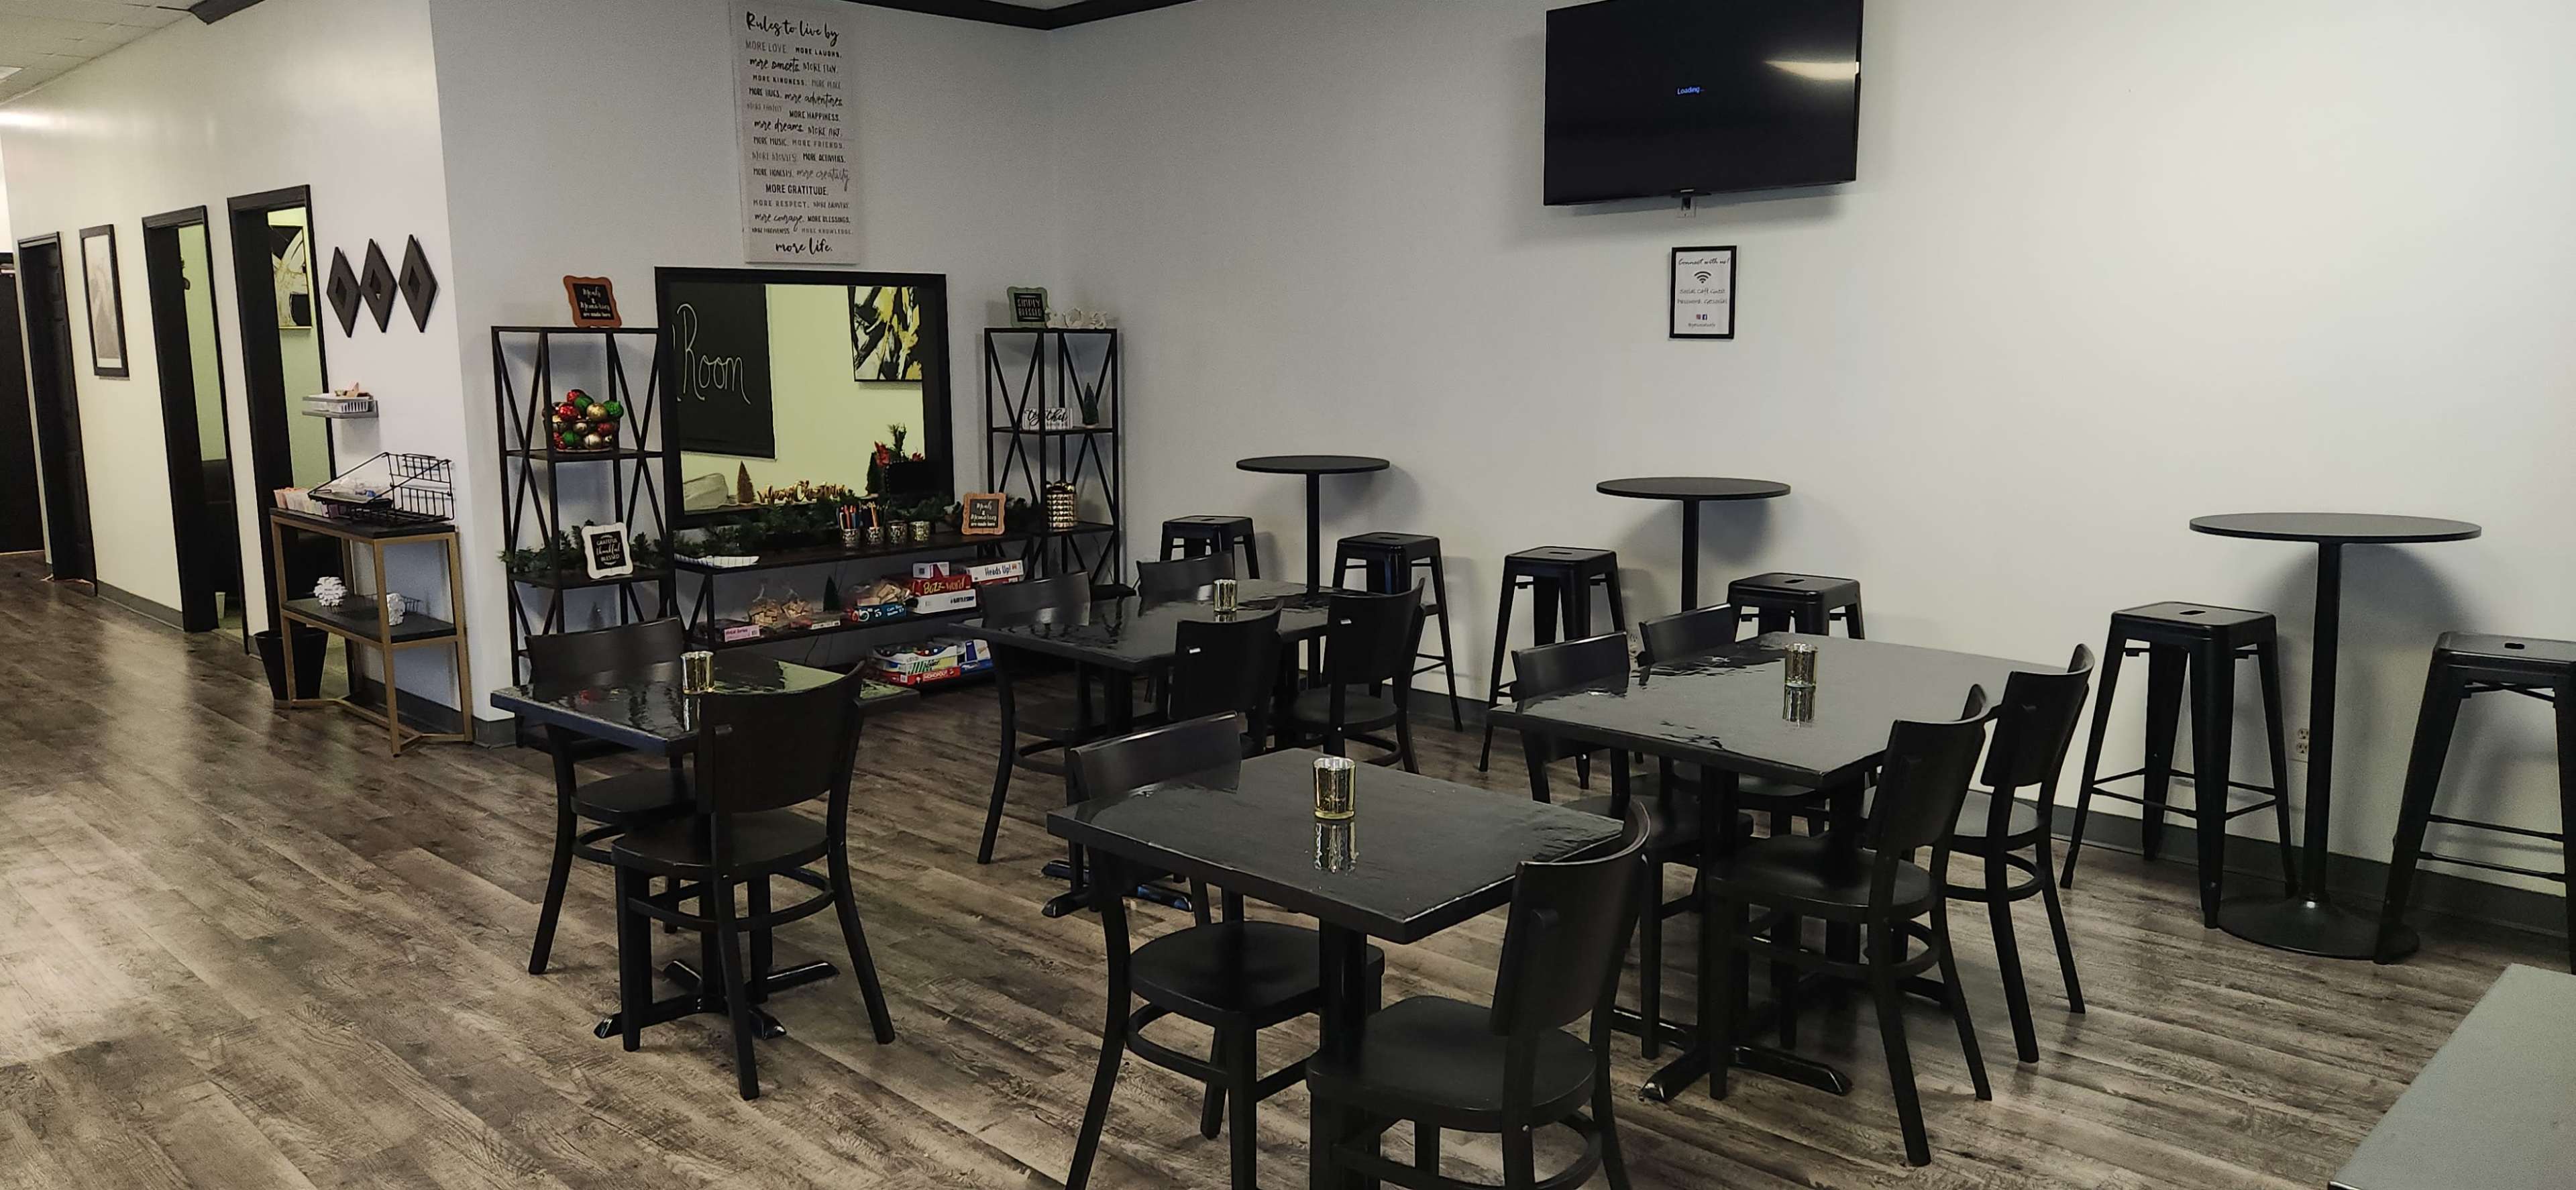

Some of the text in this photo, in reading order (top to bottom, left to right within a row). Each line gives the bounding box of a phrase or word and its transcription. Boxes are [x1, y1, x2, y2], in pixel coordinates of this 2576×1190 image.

[746, 11, 839, 47] Rules to live by
[745, 40, 766, 51] MORE
[795, 47, 812, 55] MORE
[749, 58, 768, 70] more
[753, 74, 769, 83] MORE
[749, 88, 763, 96] MORE
[784, 94, 802, 103] more
[789, 110, 805, 118] MORE
[754, 120, 771, 131] more
[808, 126, 825, 135] MORE
[753, 137, 767, 145] MORE
[803, 153, 816, 161] MORE
[765, 184, 828, 195] MORE GRATITUDE.
[755, 214, 771, 223] more
[775, 237, 833, 254] more life.
[677, 303, 751, 404] Room
[985, 567, 1002, 576] Heads
